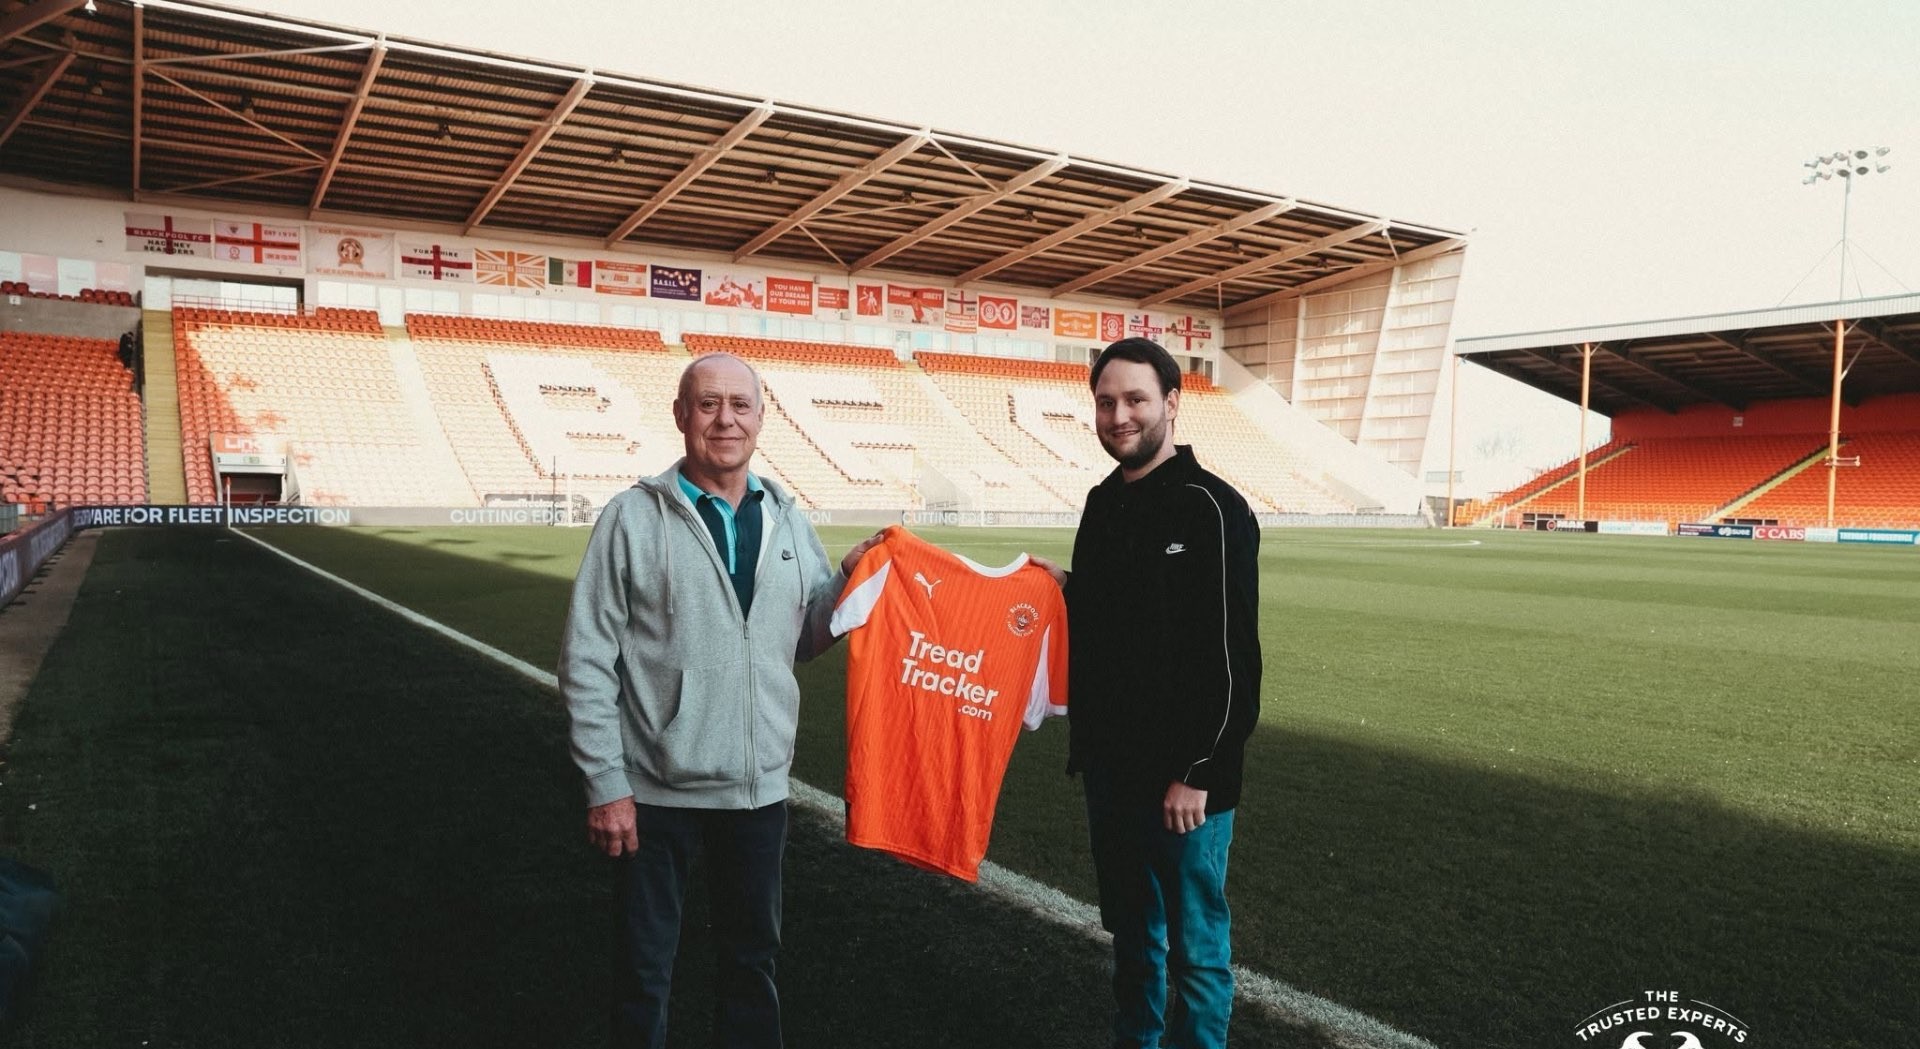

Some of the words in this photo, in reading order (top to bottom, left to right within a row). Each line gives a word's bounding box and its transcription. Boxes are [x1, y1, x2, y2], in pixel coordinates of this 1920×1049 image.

[134, 229, 189, 240] BLACKPOOL
[147, 239, 191, 249] HACNEY
[144, 245, 195, 256] SEASDERS
[413, 248, 459, 258] YORKHIRE
[417, 269, 460, 279] SEADERS
[789, 284, 806, 292] HAVE
[785, 291, 810, 300] DREAMS
[124, 507, 163, 524] FOR
[169, 507, 223, 524] FLEET
[229, 508, 350, 524] INSPECTION
[450, 508, 528, 524] CUTTING
[531, 509, 569, 524] EDG
[902, 511, 958, 525] CUTTING
[1755, 528, 1765, 538] C
[1768, 528, 1804, 539] CABS
[1010, 602, 1039, 621] BLACKPOOL
[910, 631, 984, 674] Tread
[901, 658, 999, 707] Tracker
[958, 703, 993, 721] .com
